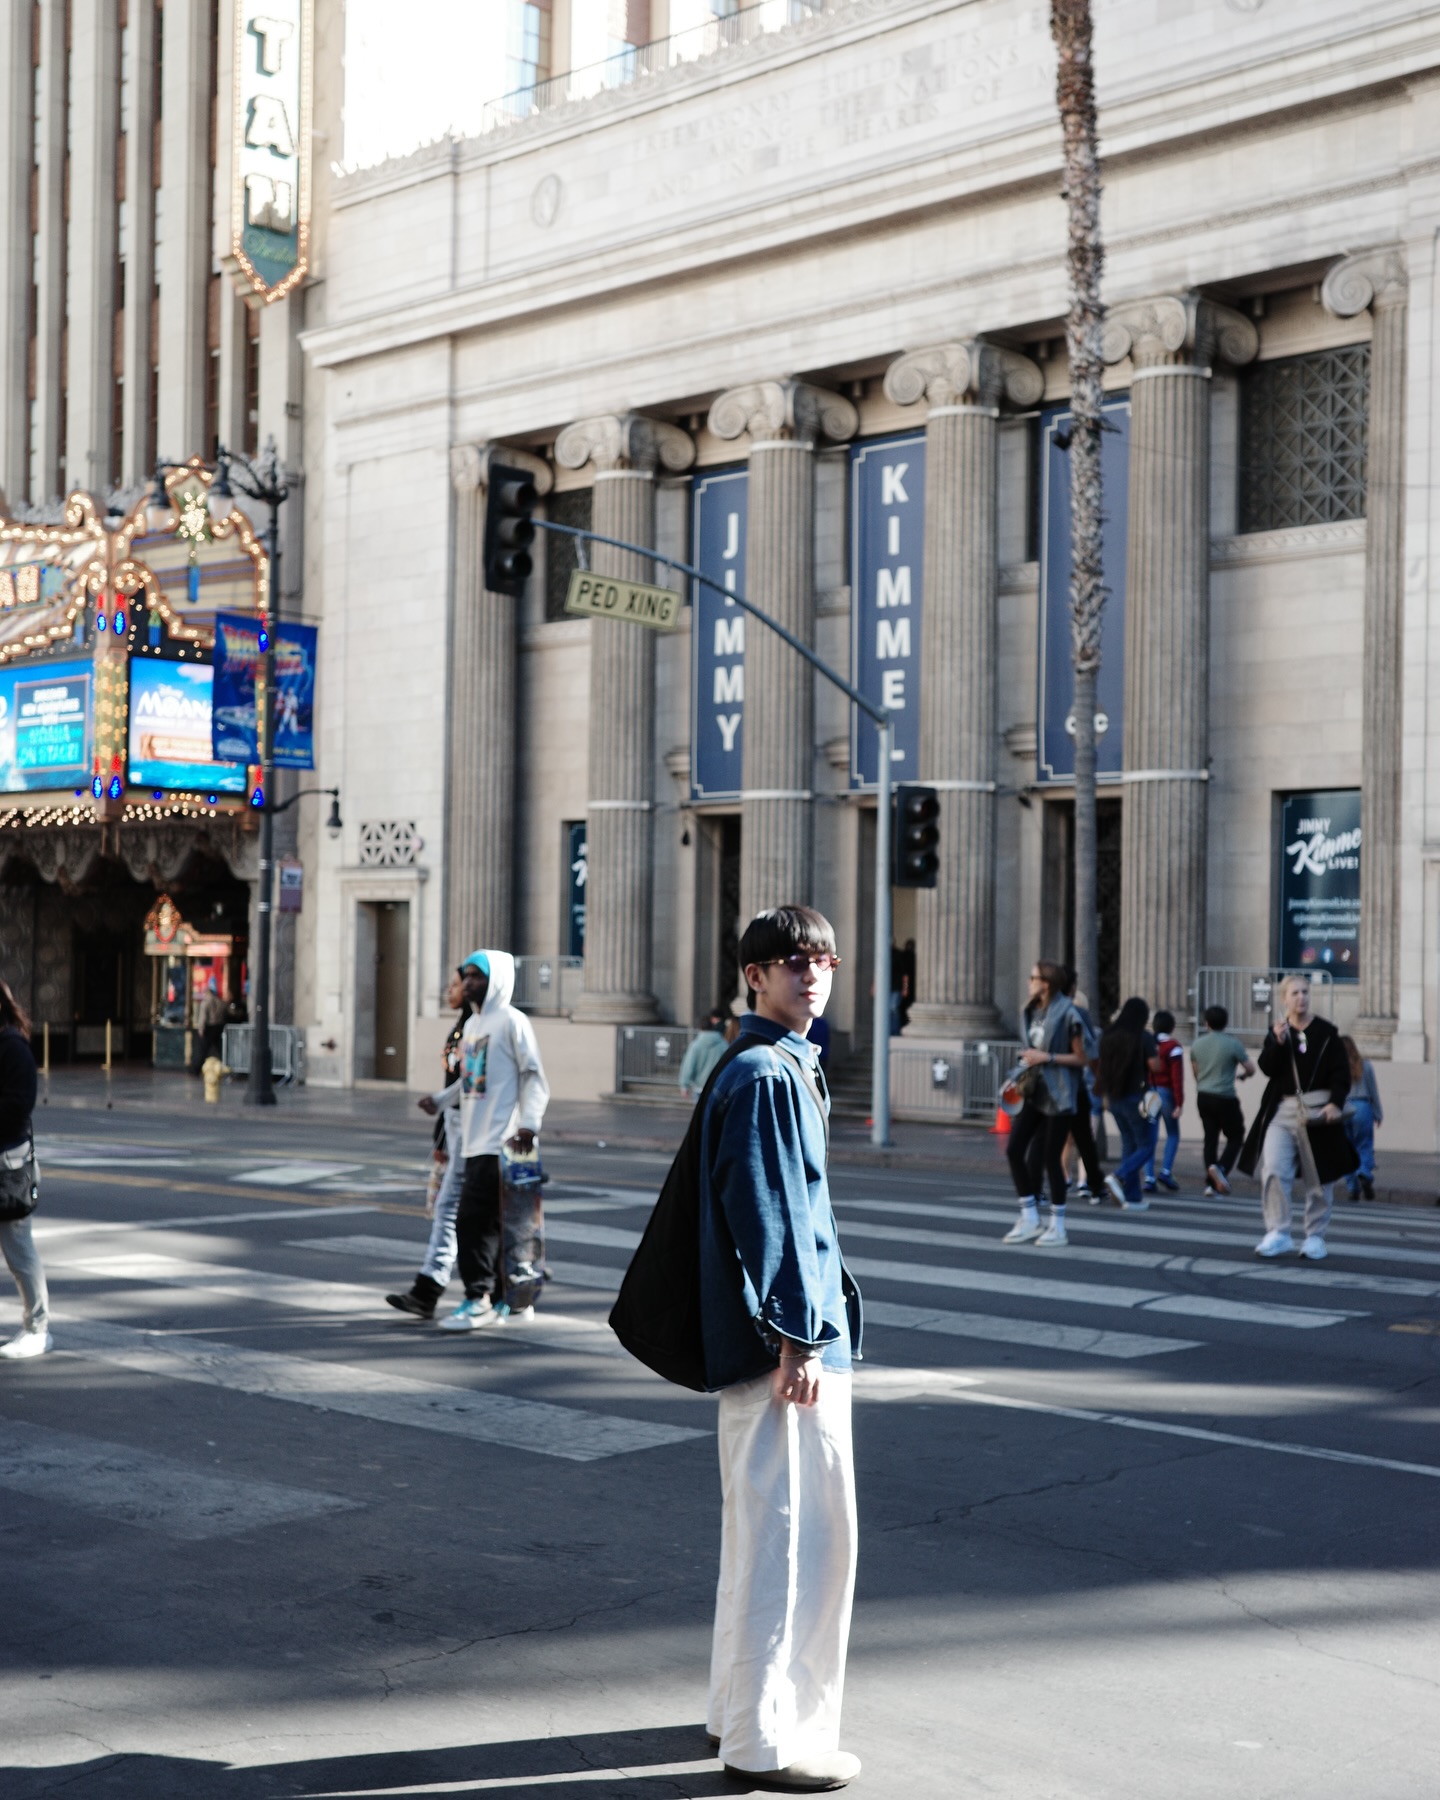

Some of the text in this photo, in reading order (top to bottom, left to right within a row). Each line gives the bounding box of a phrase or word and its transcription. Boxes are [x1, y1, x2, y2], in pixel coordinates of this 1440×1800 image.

[818, 51, 913, 98] BUILDS
[940, 31, 981, 59] ITS
[709, 118, 791, 160] AMONG
[818, 93, 864, 126] THE
[896, 46, 1018, 99] NATIONS
[647, 175, 691, 204] AND
[843, 98, 939, 146] HEARTS
[971, 78, 1004, 105] OF
[576, 581, 671, 621] PED XING
[713, 512, 745, 752] JIMMY
[1286, 828, 1362, 876] Kimme
[1296, 818, 1331, 834] JIMMY
[1328, 856, 1359, 869] LIVE!
